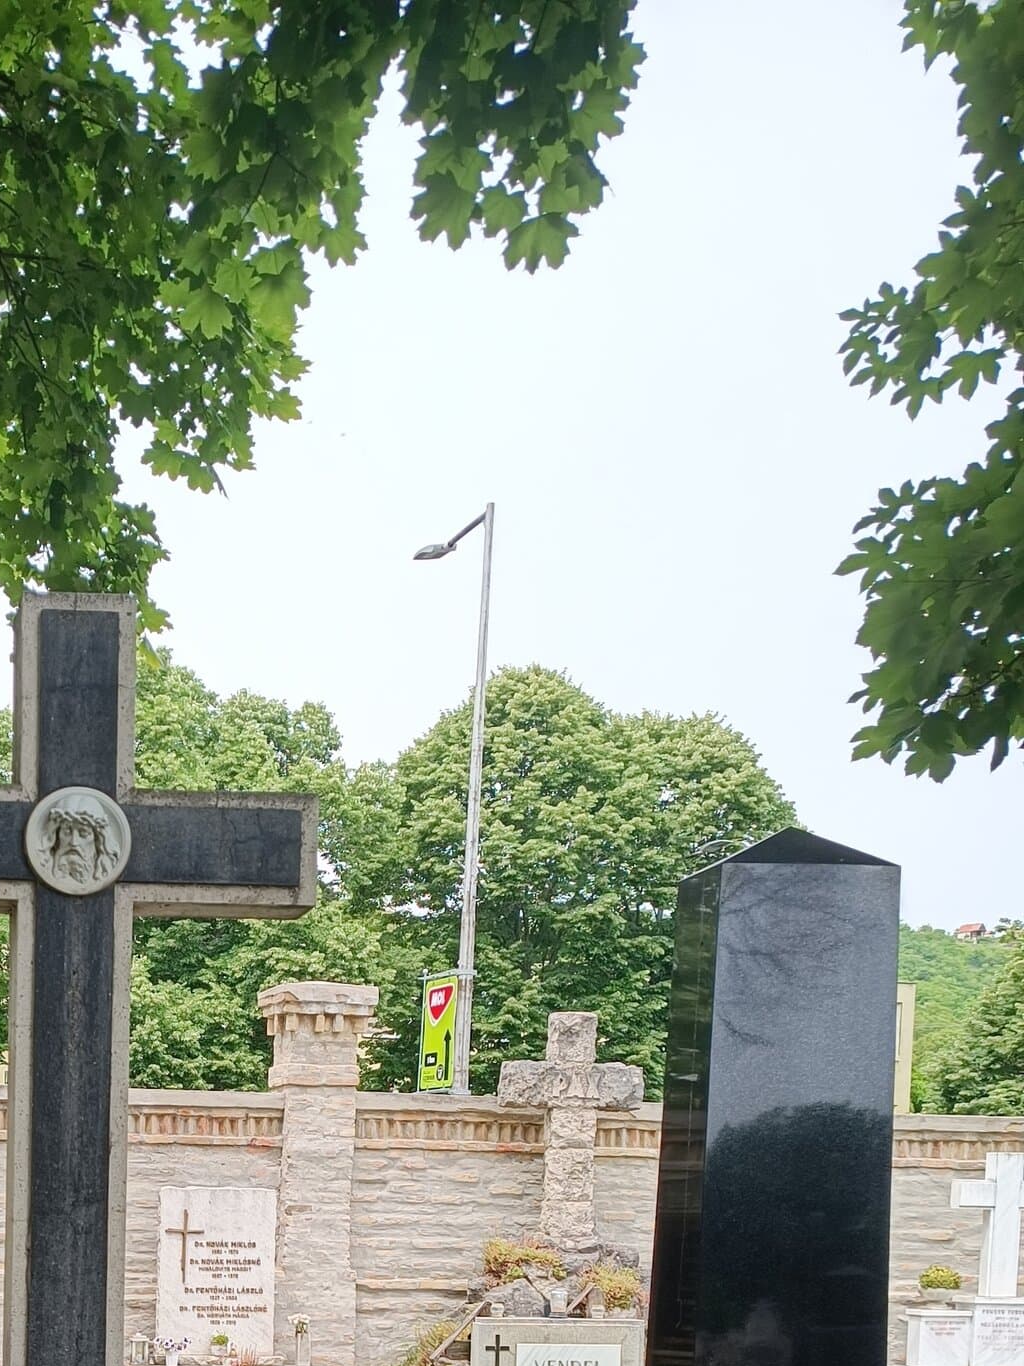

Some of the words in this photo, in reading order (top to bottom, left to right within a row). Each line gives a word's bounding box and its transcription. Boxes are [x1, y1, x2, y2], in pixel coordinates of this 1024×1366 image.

[552, 1070, 601, 1099] PAX
[206, 1238, 229, 1248] NOVÁK
[230, 1240, 256, 1248] MIKLÓS
[201, 1257, 224, 1265] NOVÁK
[236, 1286, 263, 1294] LÁSZLÓ
